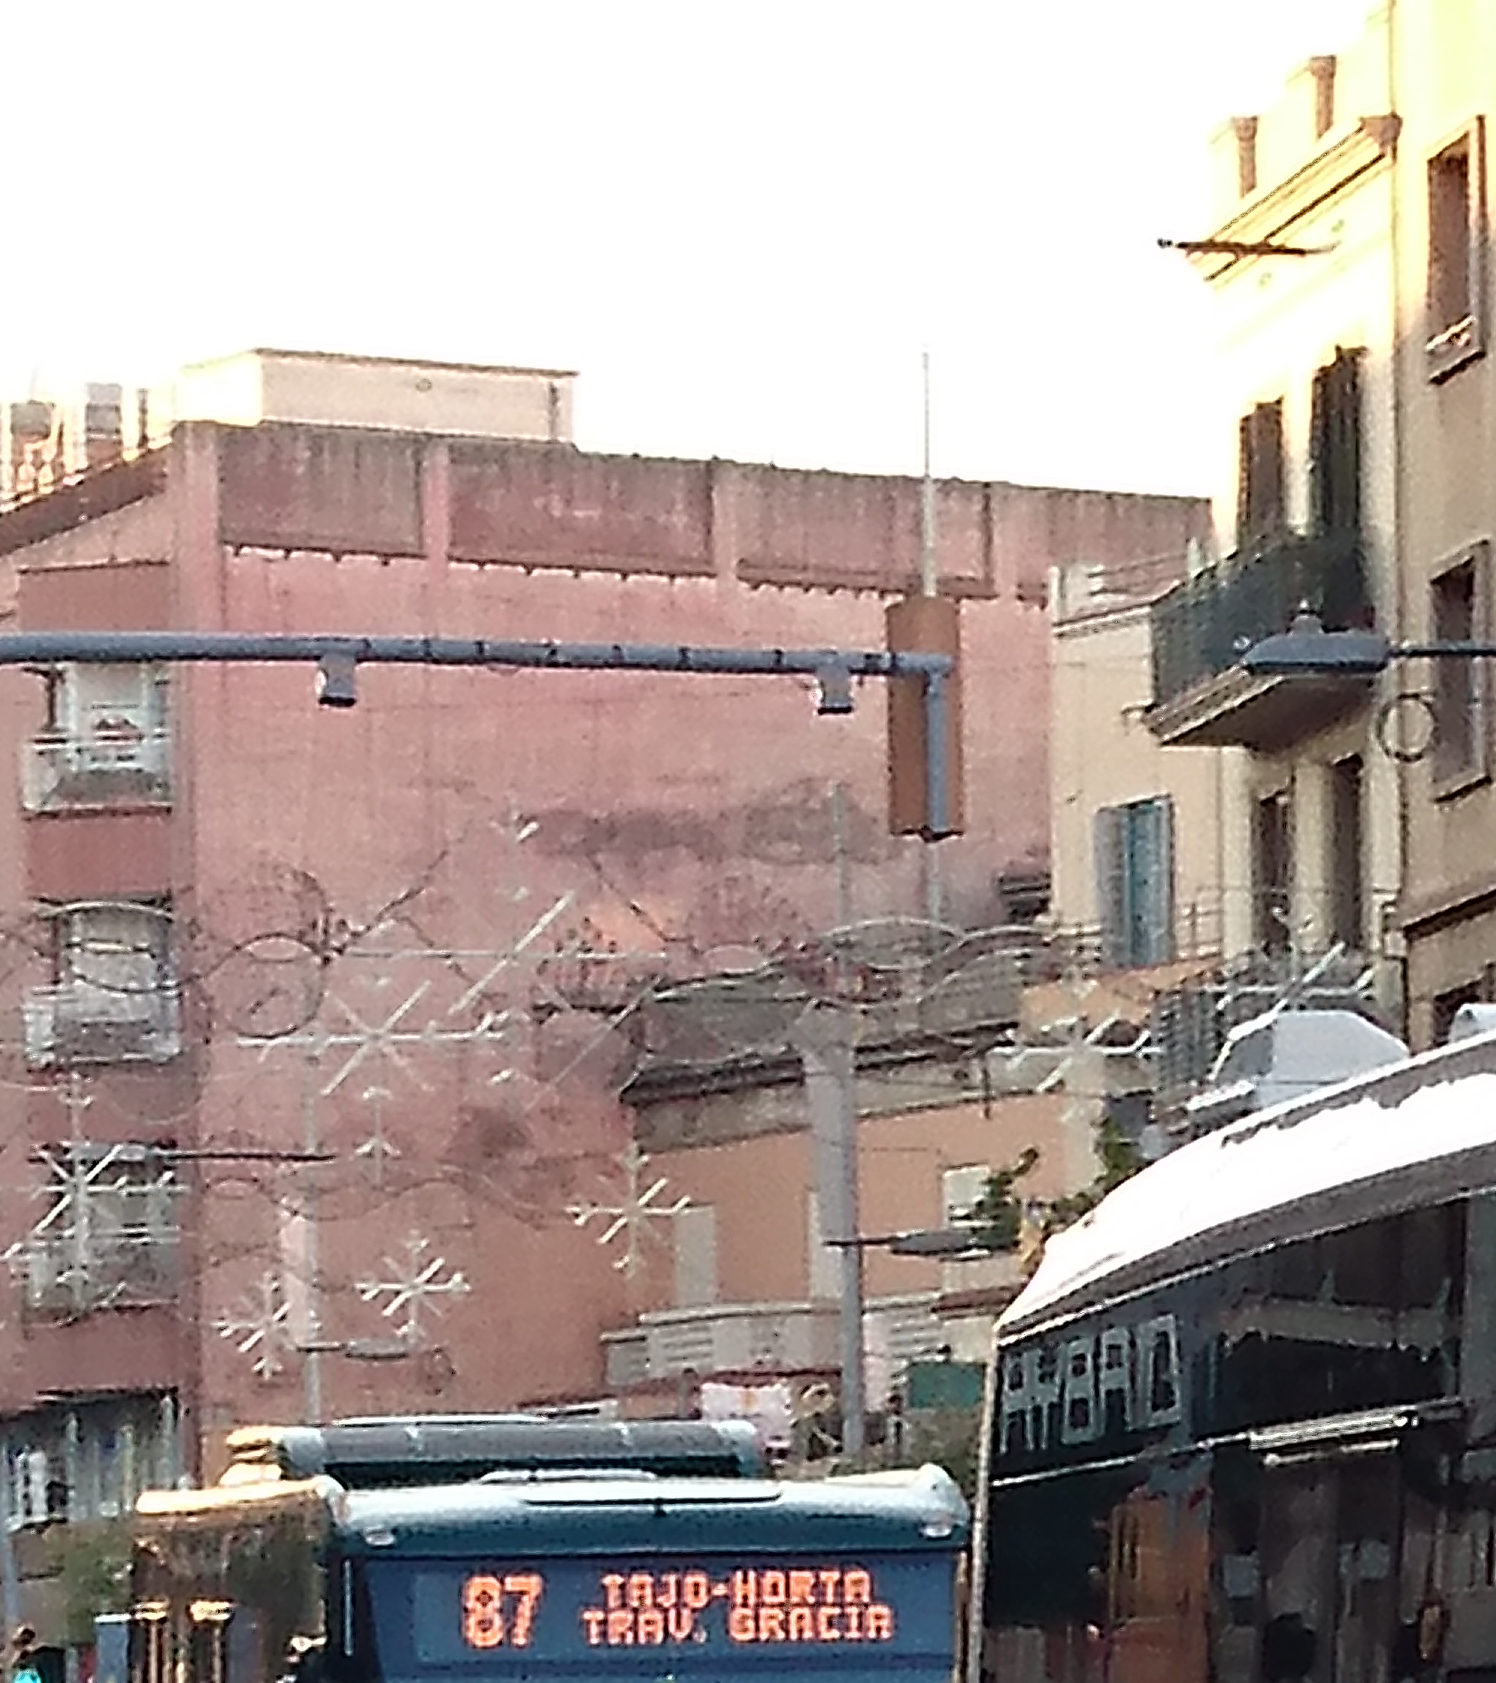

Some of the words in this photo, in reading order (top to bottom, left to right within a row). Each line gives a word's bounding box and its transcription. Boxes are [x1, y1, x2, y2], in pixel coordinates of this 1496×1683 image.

[461, 1573, 544, 1647] 87
[600, 1569, 872, 1610] TAJO-HORTA
[582, 1608, 708, 1647] TRAV.
[727, 1603, 895, 1643] GRACIA
